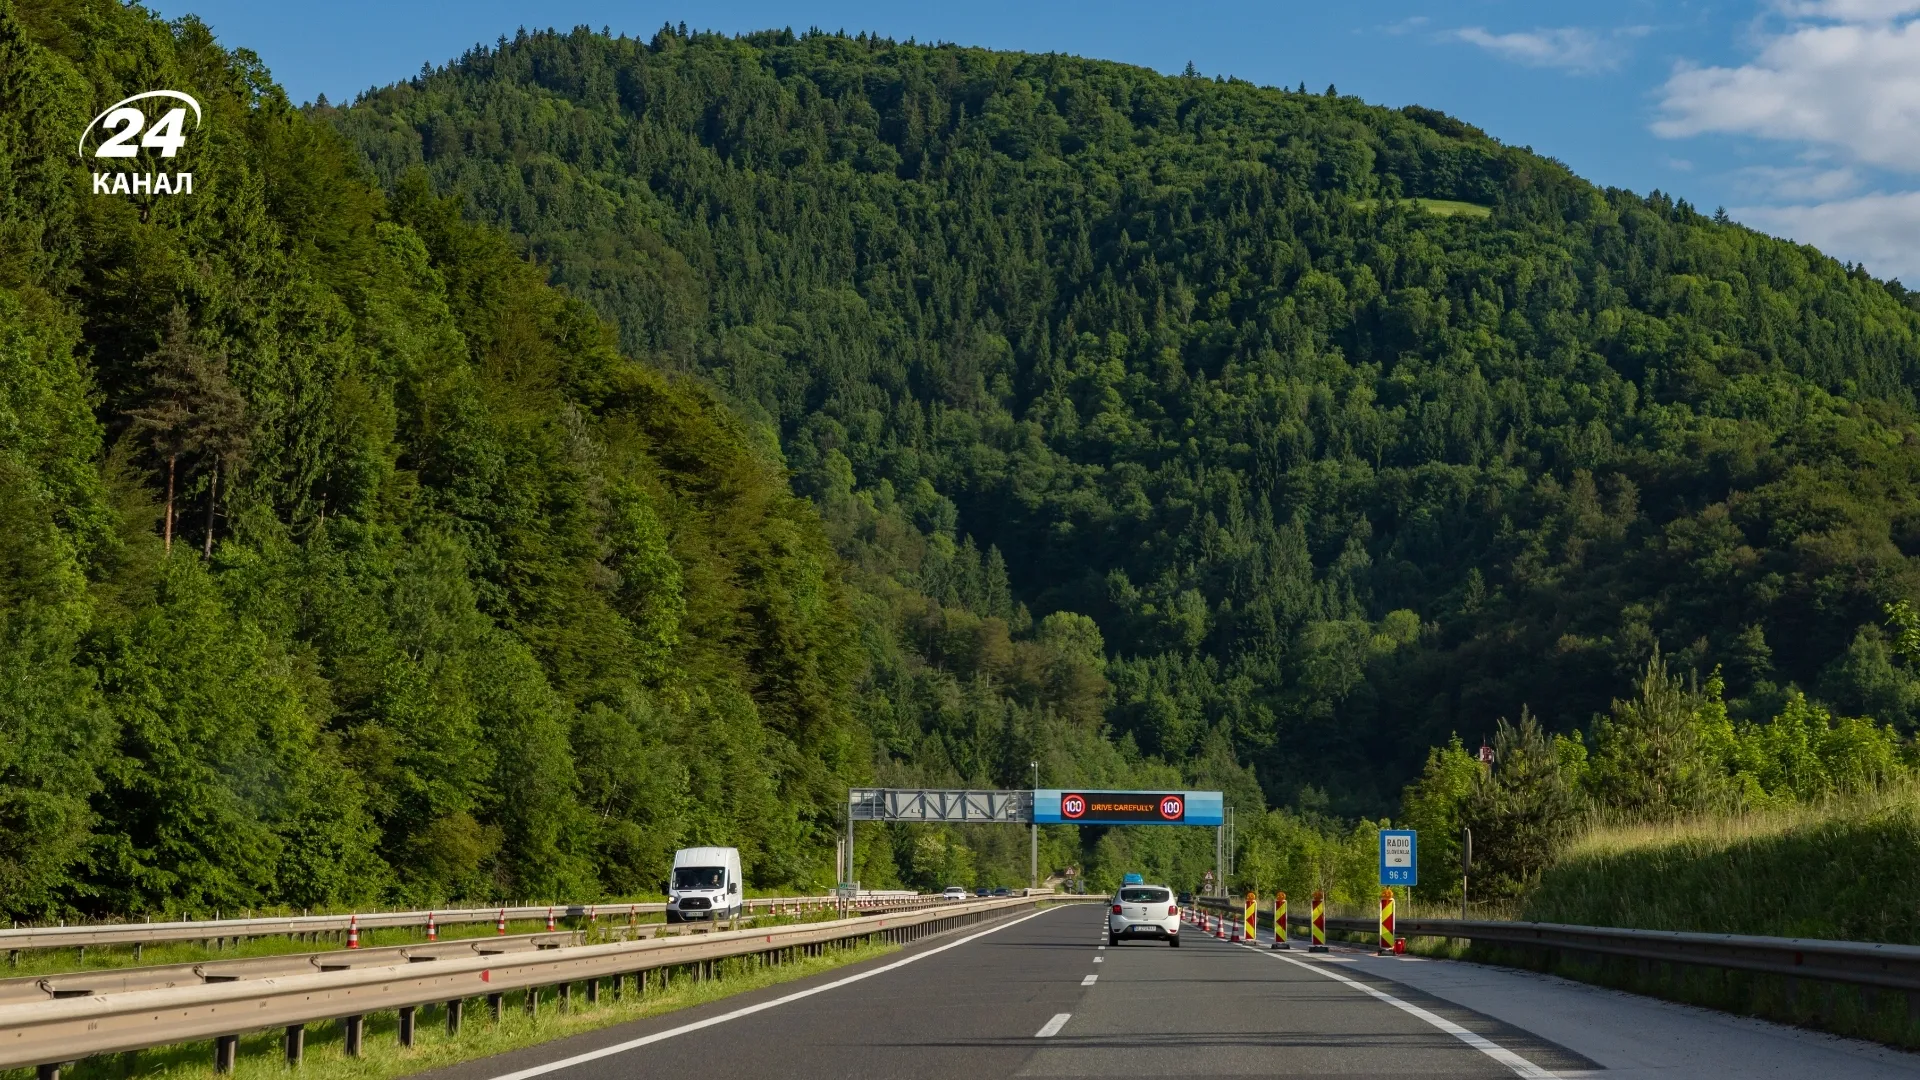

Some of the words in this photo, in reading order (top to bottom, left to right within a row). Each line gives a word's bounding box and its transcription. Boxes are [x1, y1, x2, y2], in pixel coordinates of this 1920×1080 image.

[1065, 800, 1082, 812] 100
[1163, 801, 1180, 813] 100
[1387, 839, 1409, 847] RADIO
[1389, 870, 1408, 879] 96.9
